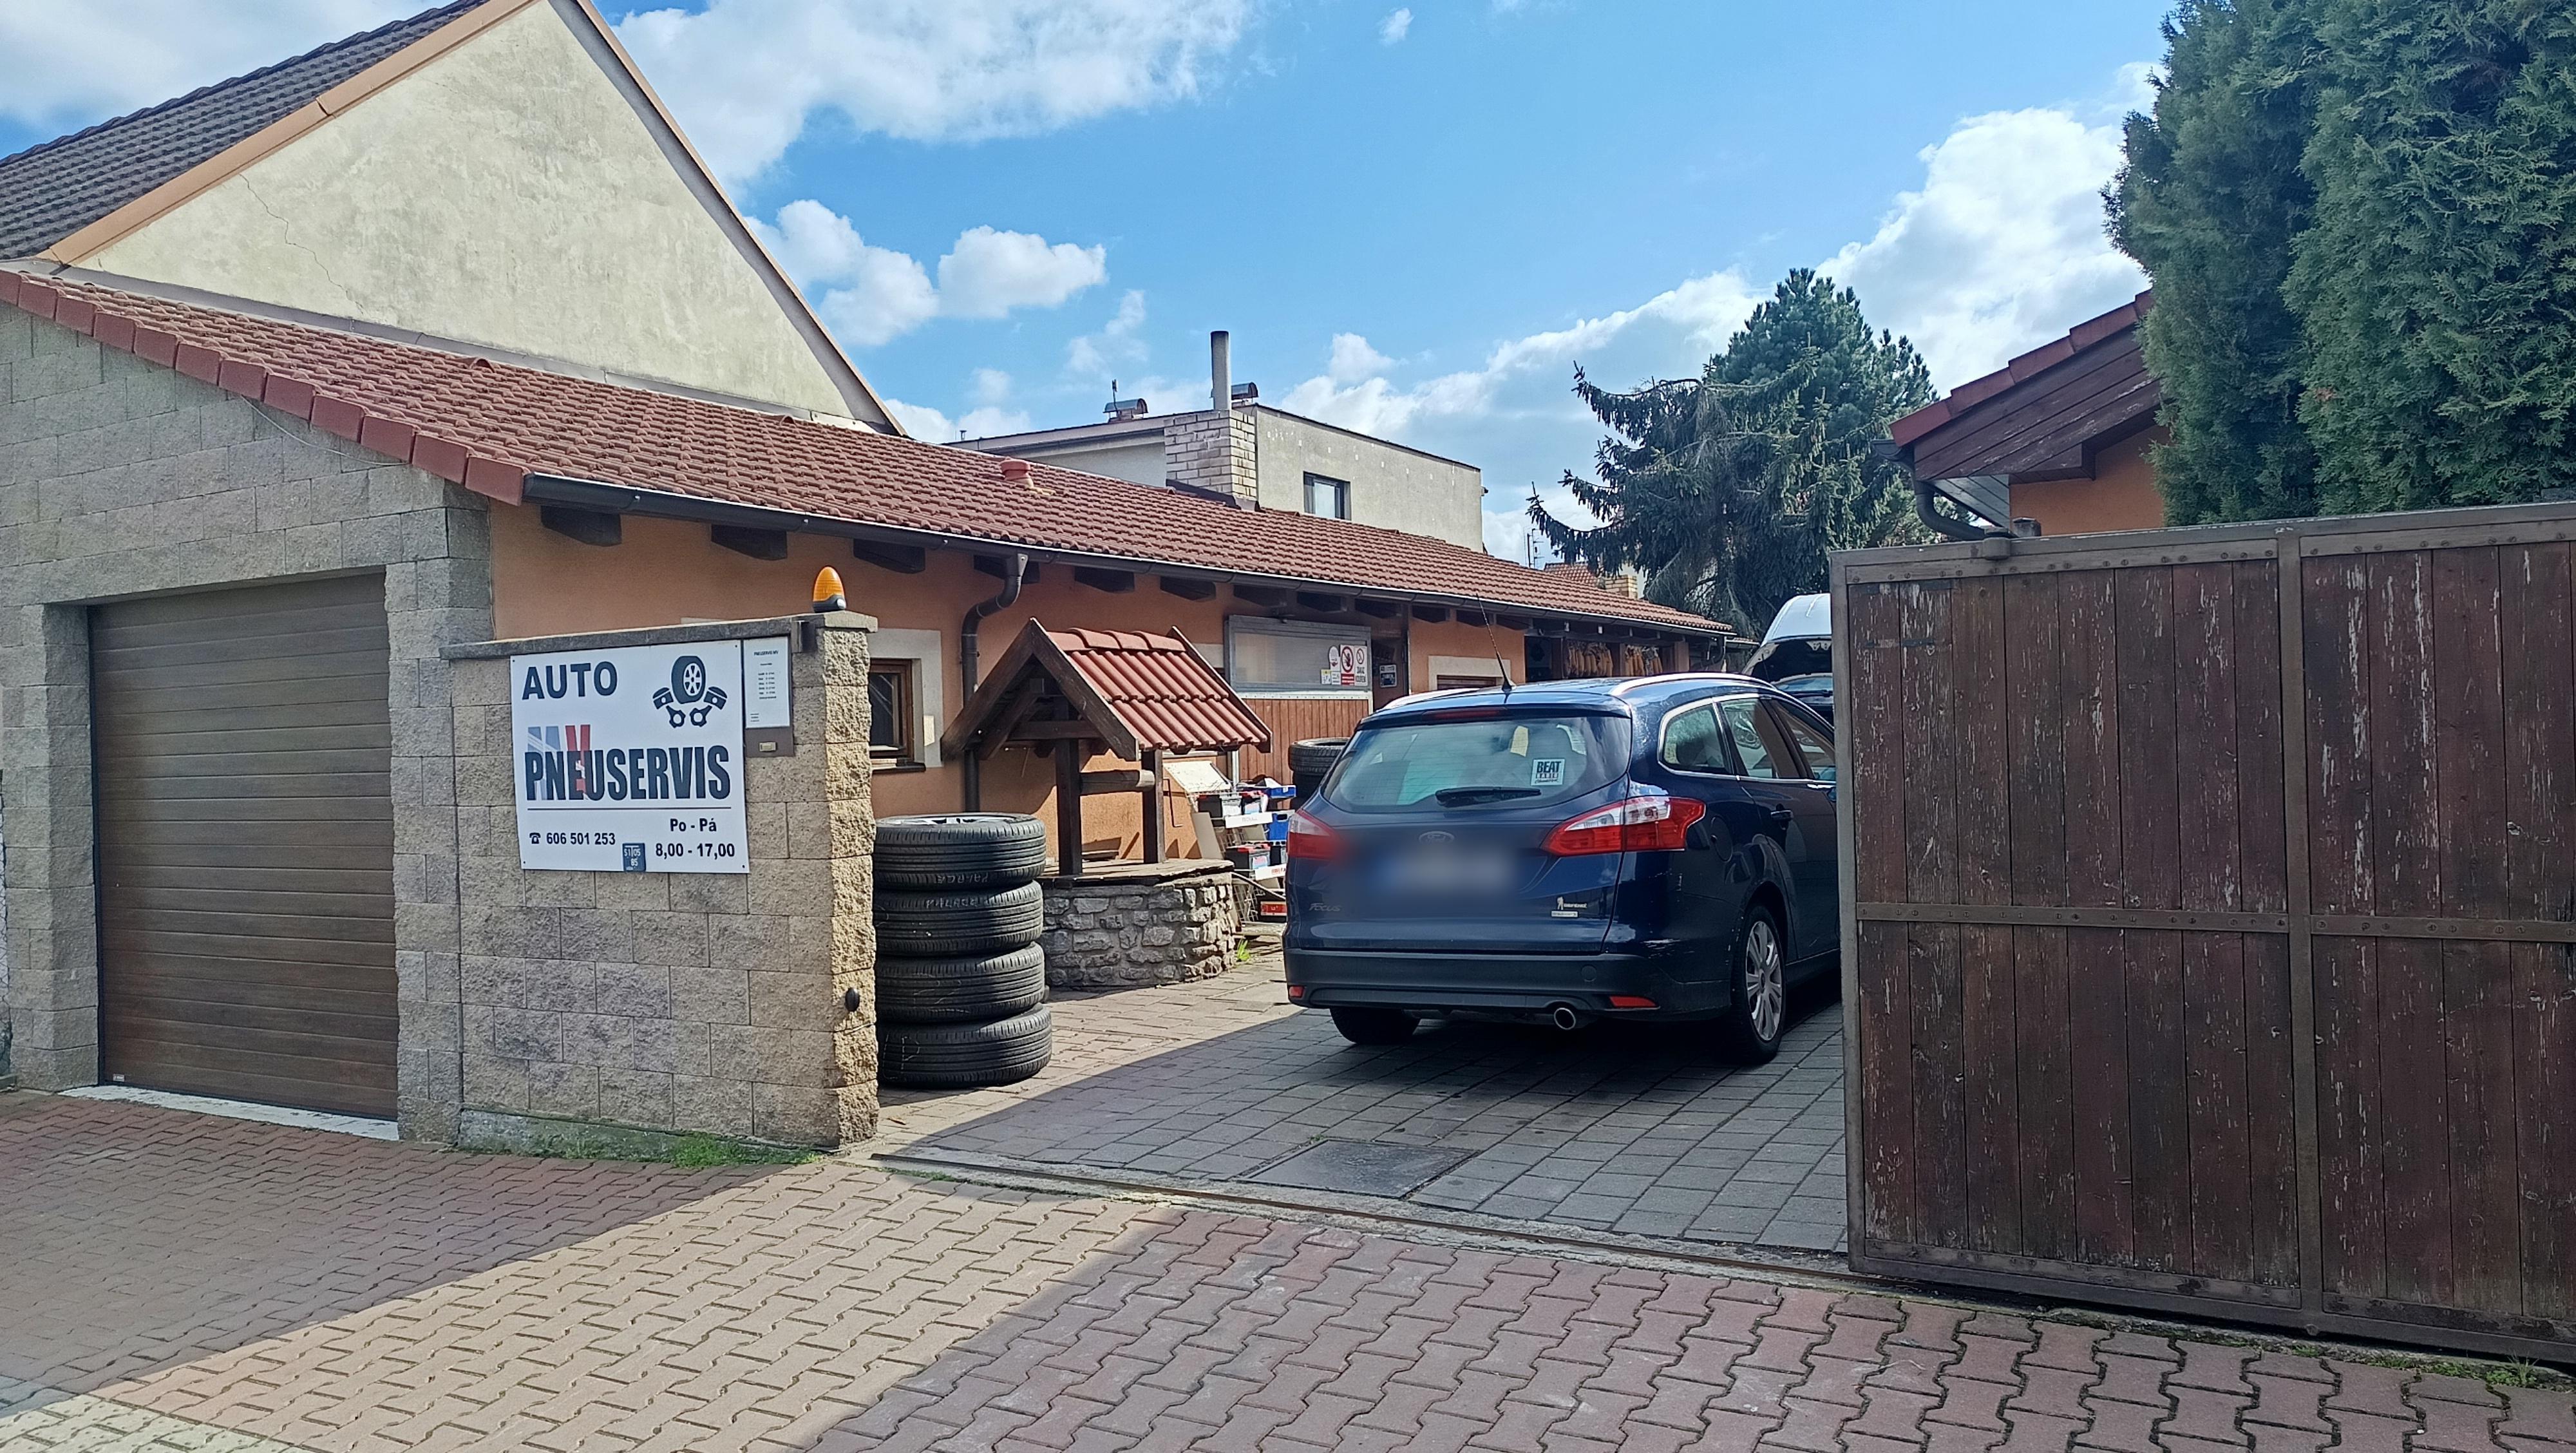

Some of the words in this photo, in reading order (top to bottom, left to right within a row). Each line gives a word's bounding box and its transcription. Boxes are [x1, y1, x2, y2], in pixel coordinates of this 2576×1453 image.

[522, 661, 617, 699] AUTO
[525, 746, 730, 801] PNEUSERVIS
[1537, 761, 1562, 773] BEAT
[670, 819, 686, 831] Po
[699, 817, 717, 831] Pá
[547, 833, 567, 845] 606
[571, 832, 590, 845] 501
[595, 832, 616, 845] 253
[656, 843, 684, 859] 8,00
[697, 842, 735, 859] 17,00
